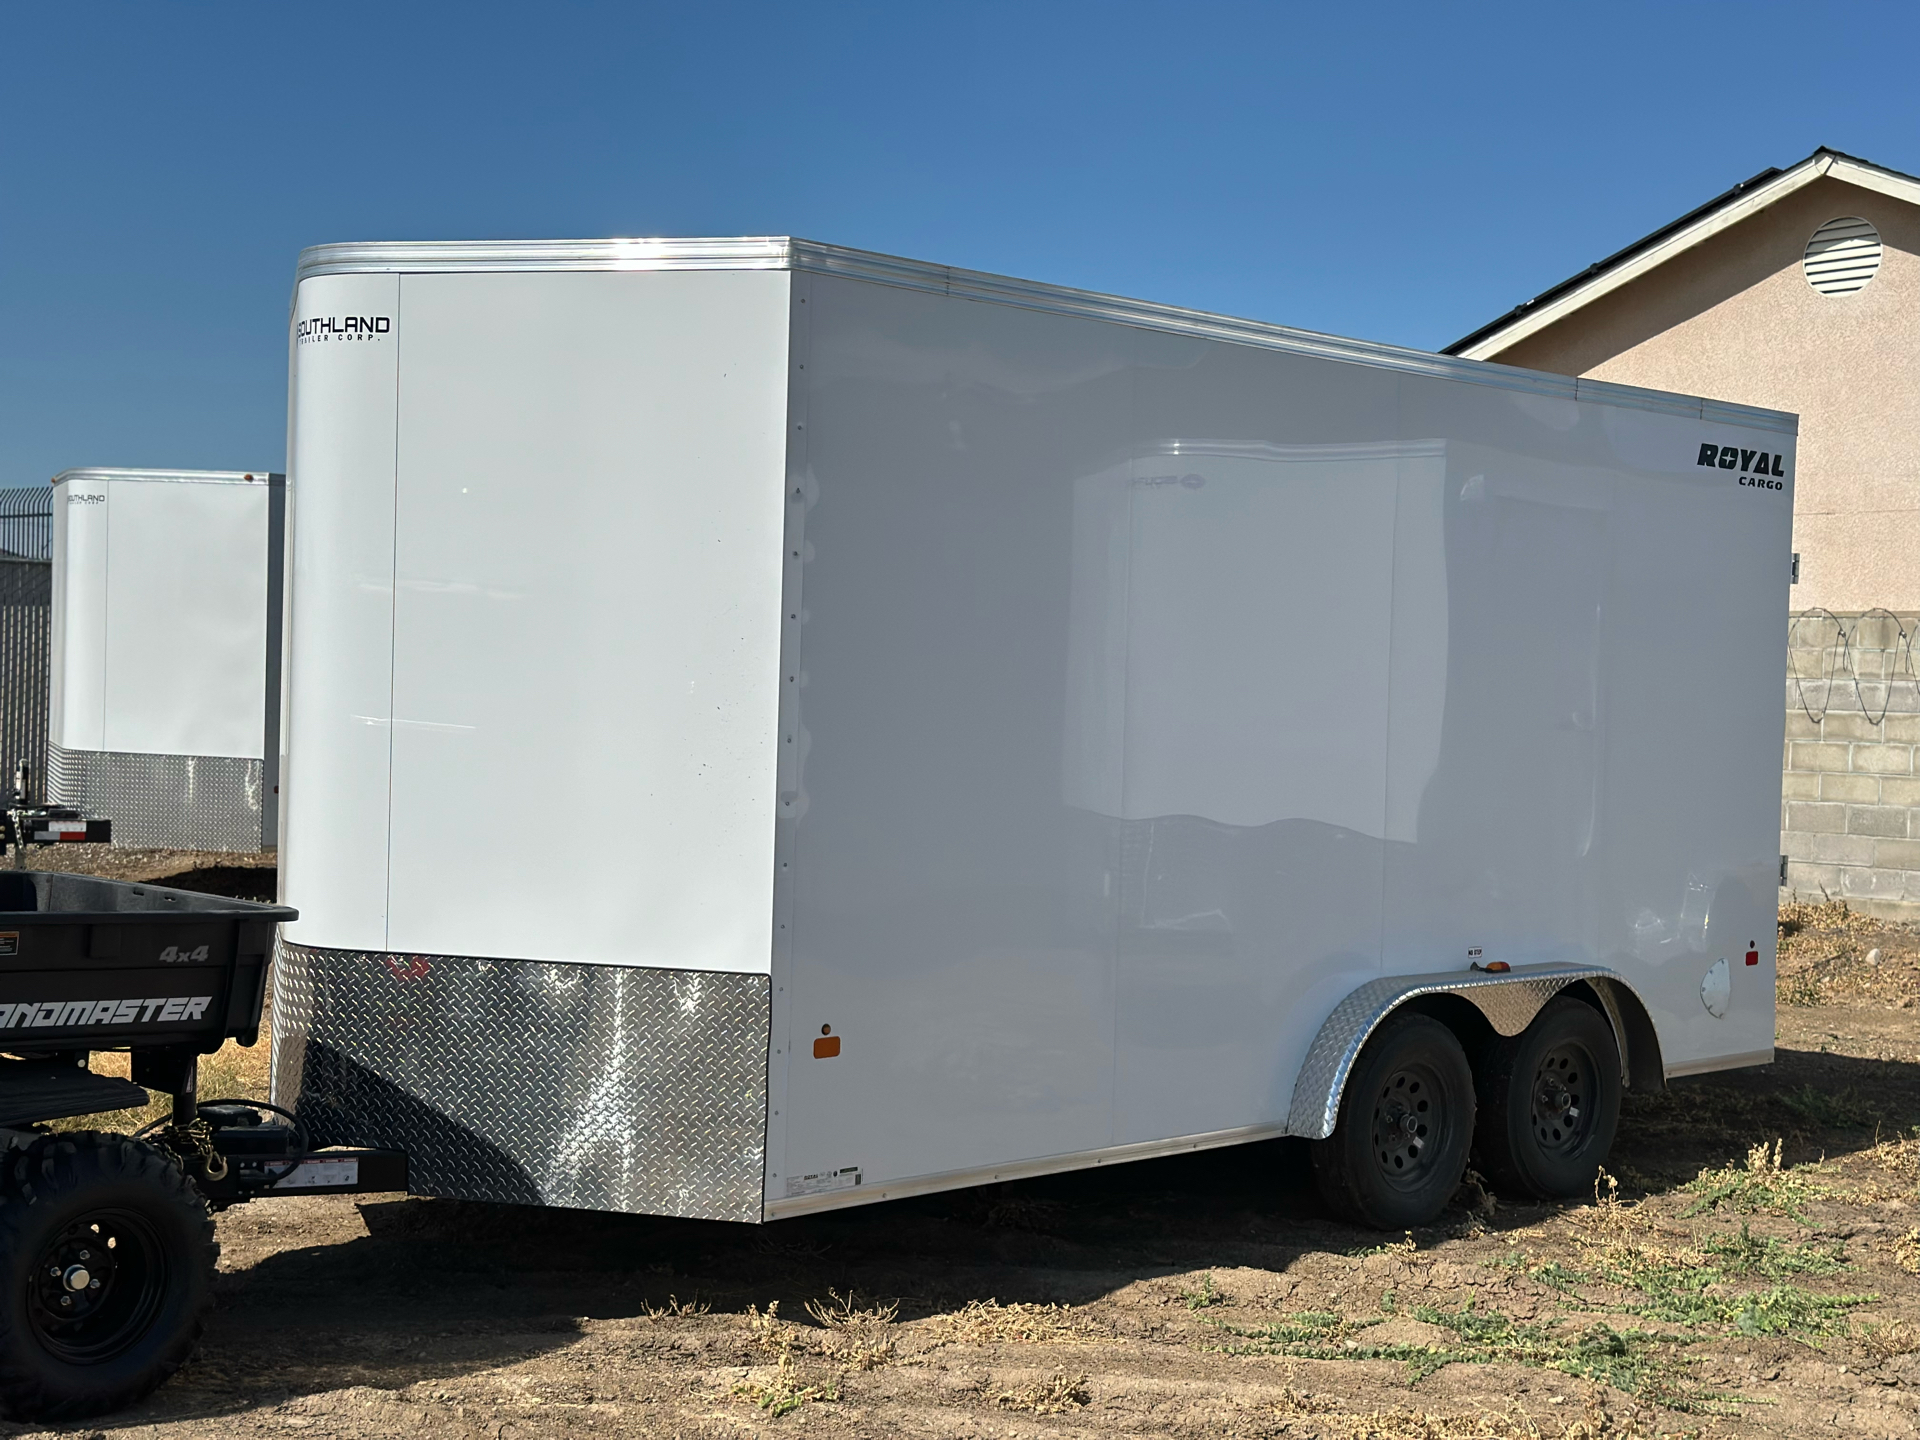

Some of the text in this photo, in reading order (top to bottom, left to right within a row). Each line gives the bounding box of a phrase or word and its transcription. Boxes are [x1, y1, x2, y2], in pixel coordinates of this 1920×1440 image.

[338, 334, 381, 342] CORP.
[1697, 443, 1785, 477] ROYAL
[1738, 476, 1783, 491] CARGO
[159, 945, 209, 963] 4x4
